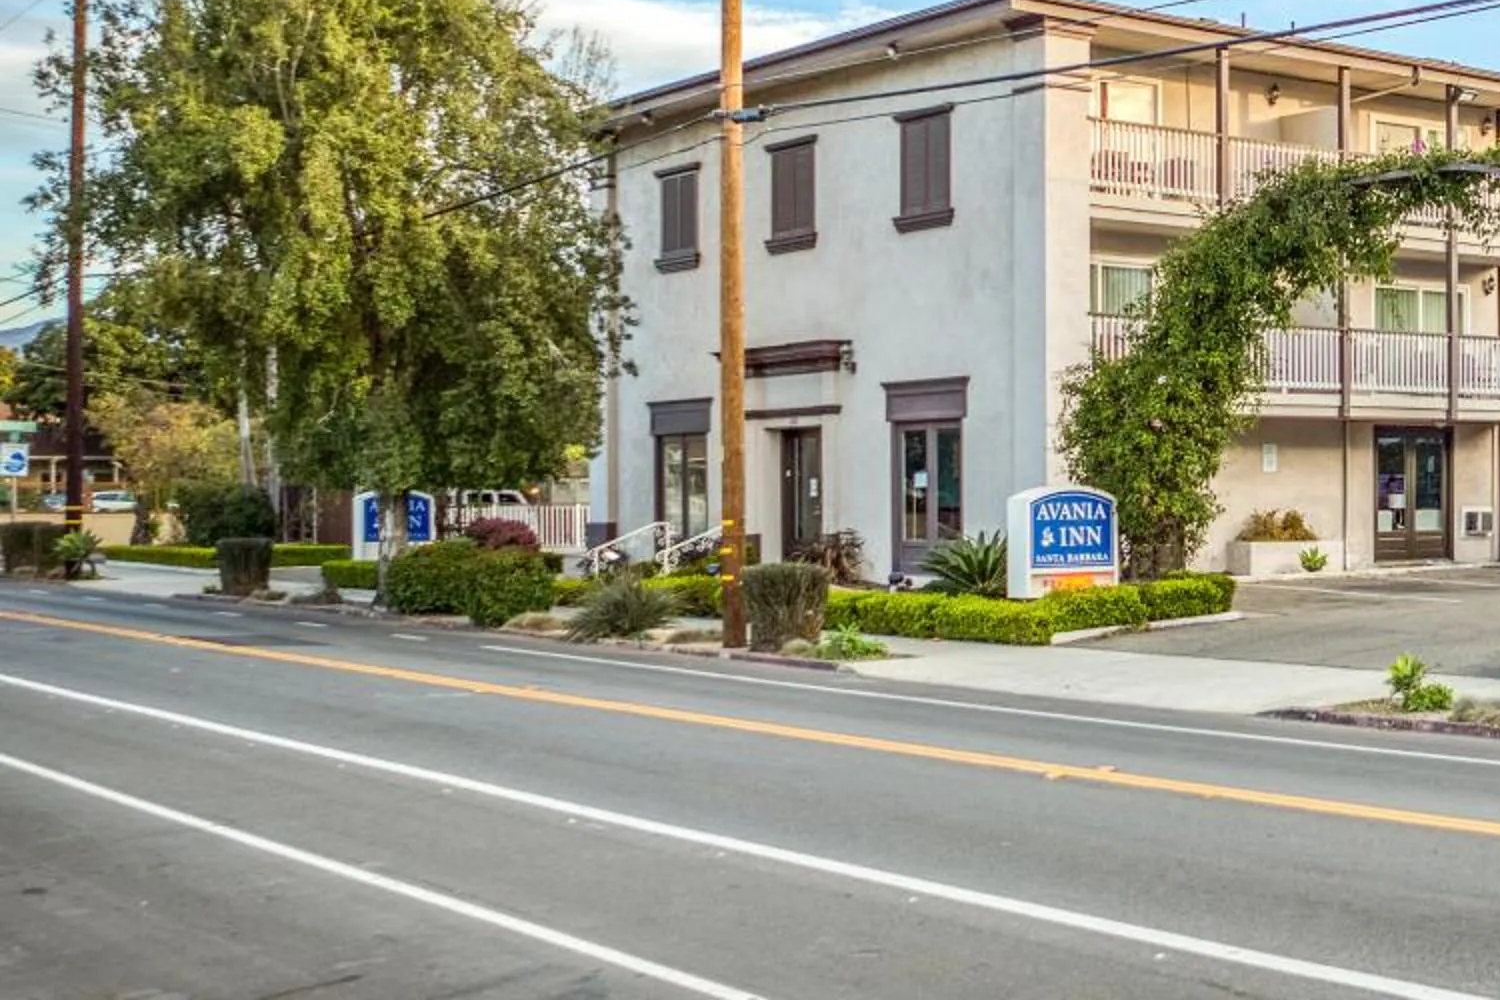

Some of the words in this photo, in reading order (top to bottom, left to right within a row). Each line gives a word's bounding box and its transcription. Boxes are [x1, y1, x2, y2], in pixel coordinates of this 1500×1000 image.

[1036, 502, 1107, 520] AVANIA
[1059, 526, 1102, 546] INN
[1036, 554, 1064, 563] SANTA
[1067, 553, 1109, 562] BARBARA
